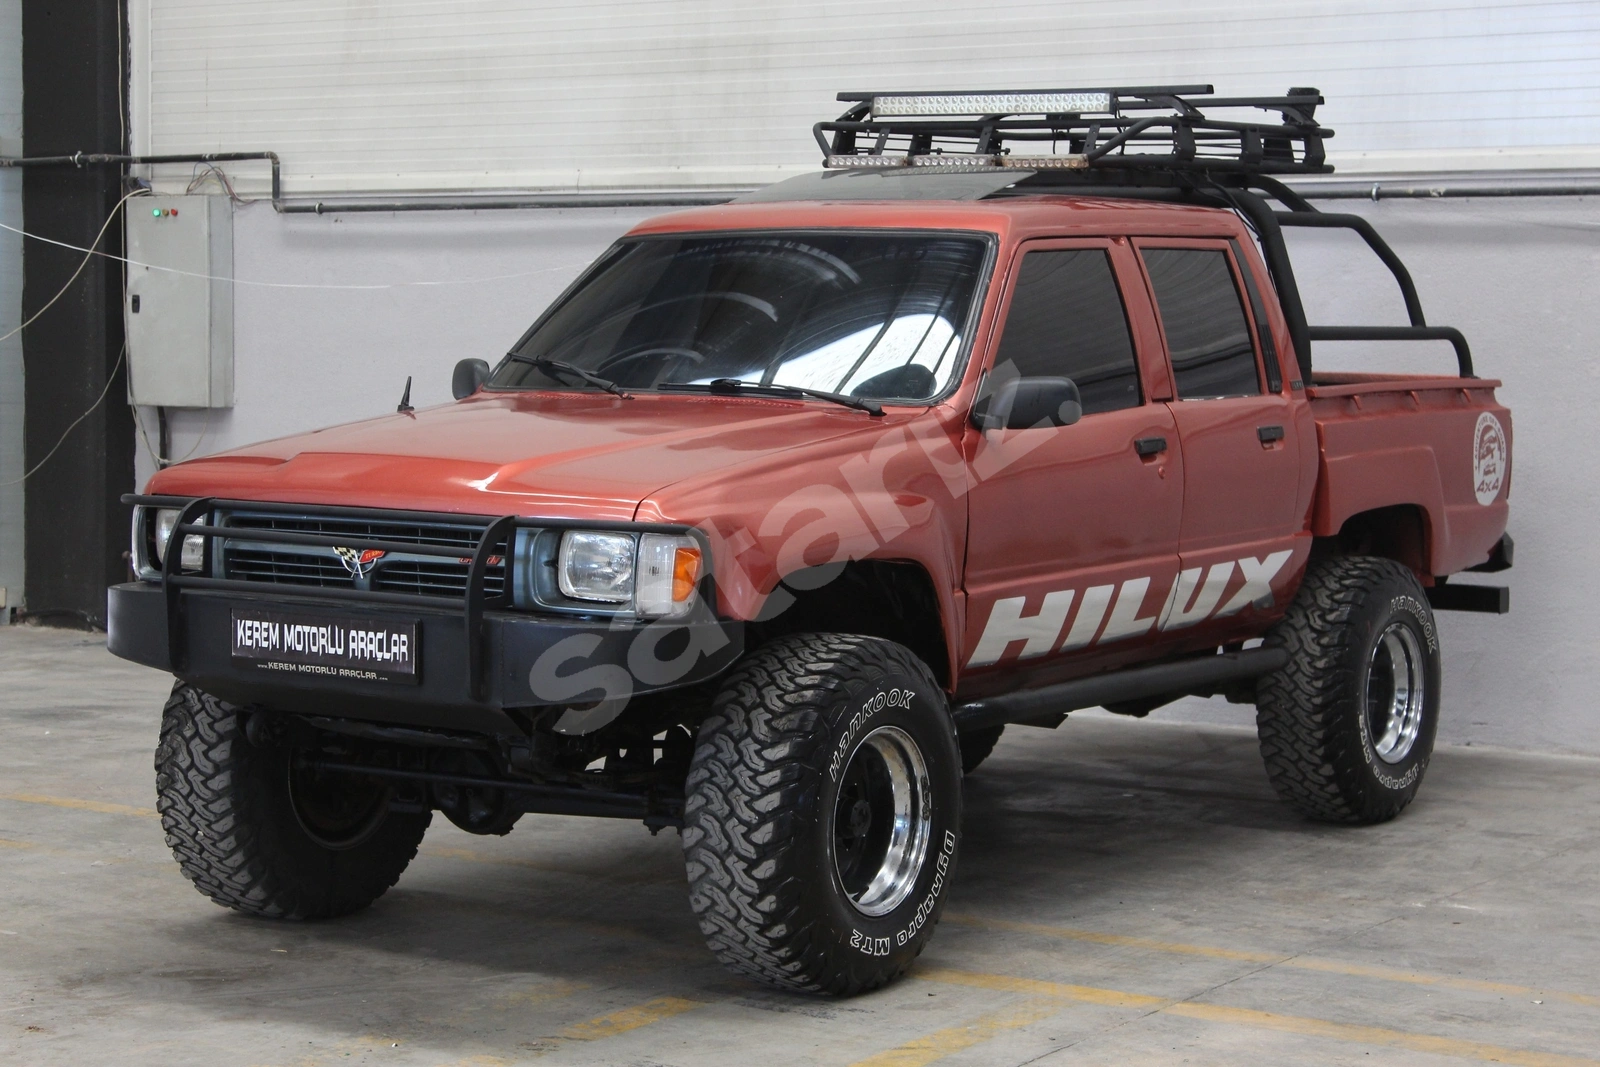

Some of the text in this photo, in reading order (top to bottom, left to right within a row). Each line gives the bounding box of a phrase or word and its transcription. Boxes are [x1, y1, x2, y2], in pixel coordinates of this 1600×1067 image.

[237, 619, 409, 663] KEREM MOTORLU ARAÇLAR
[965, 549, 1293, 669] HILUX
[298, 664, 337, 675] MOTORLU
[339, 668, 378, 680] ARAÇLAR
[896, 830, 956, 946] Dynapro
